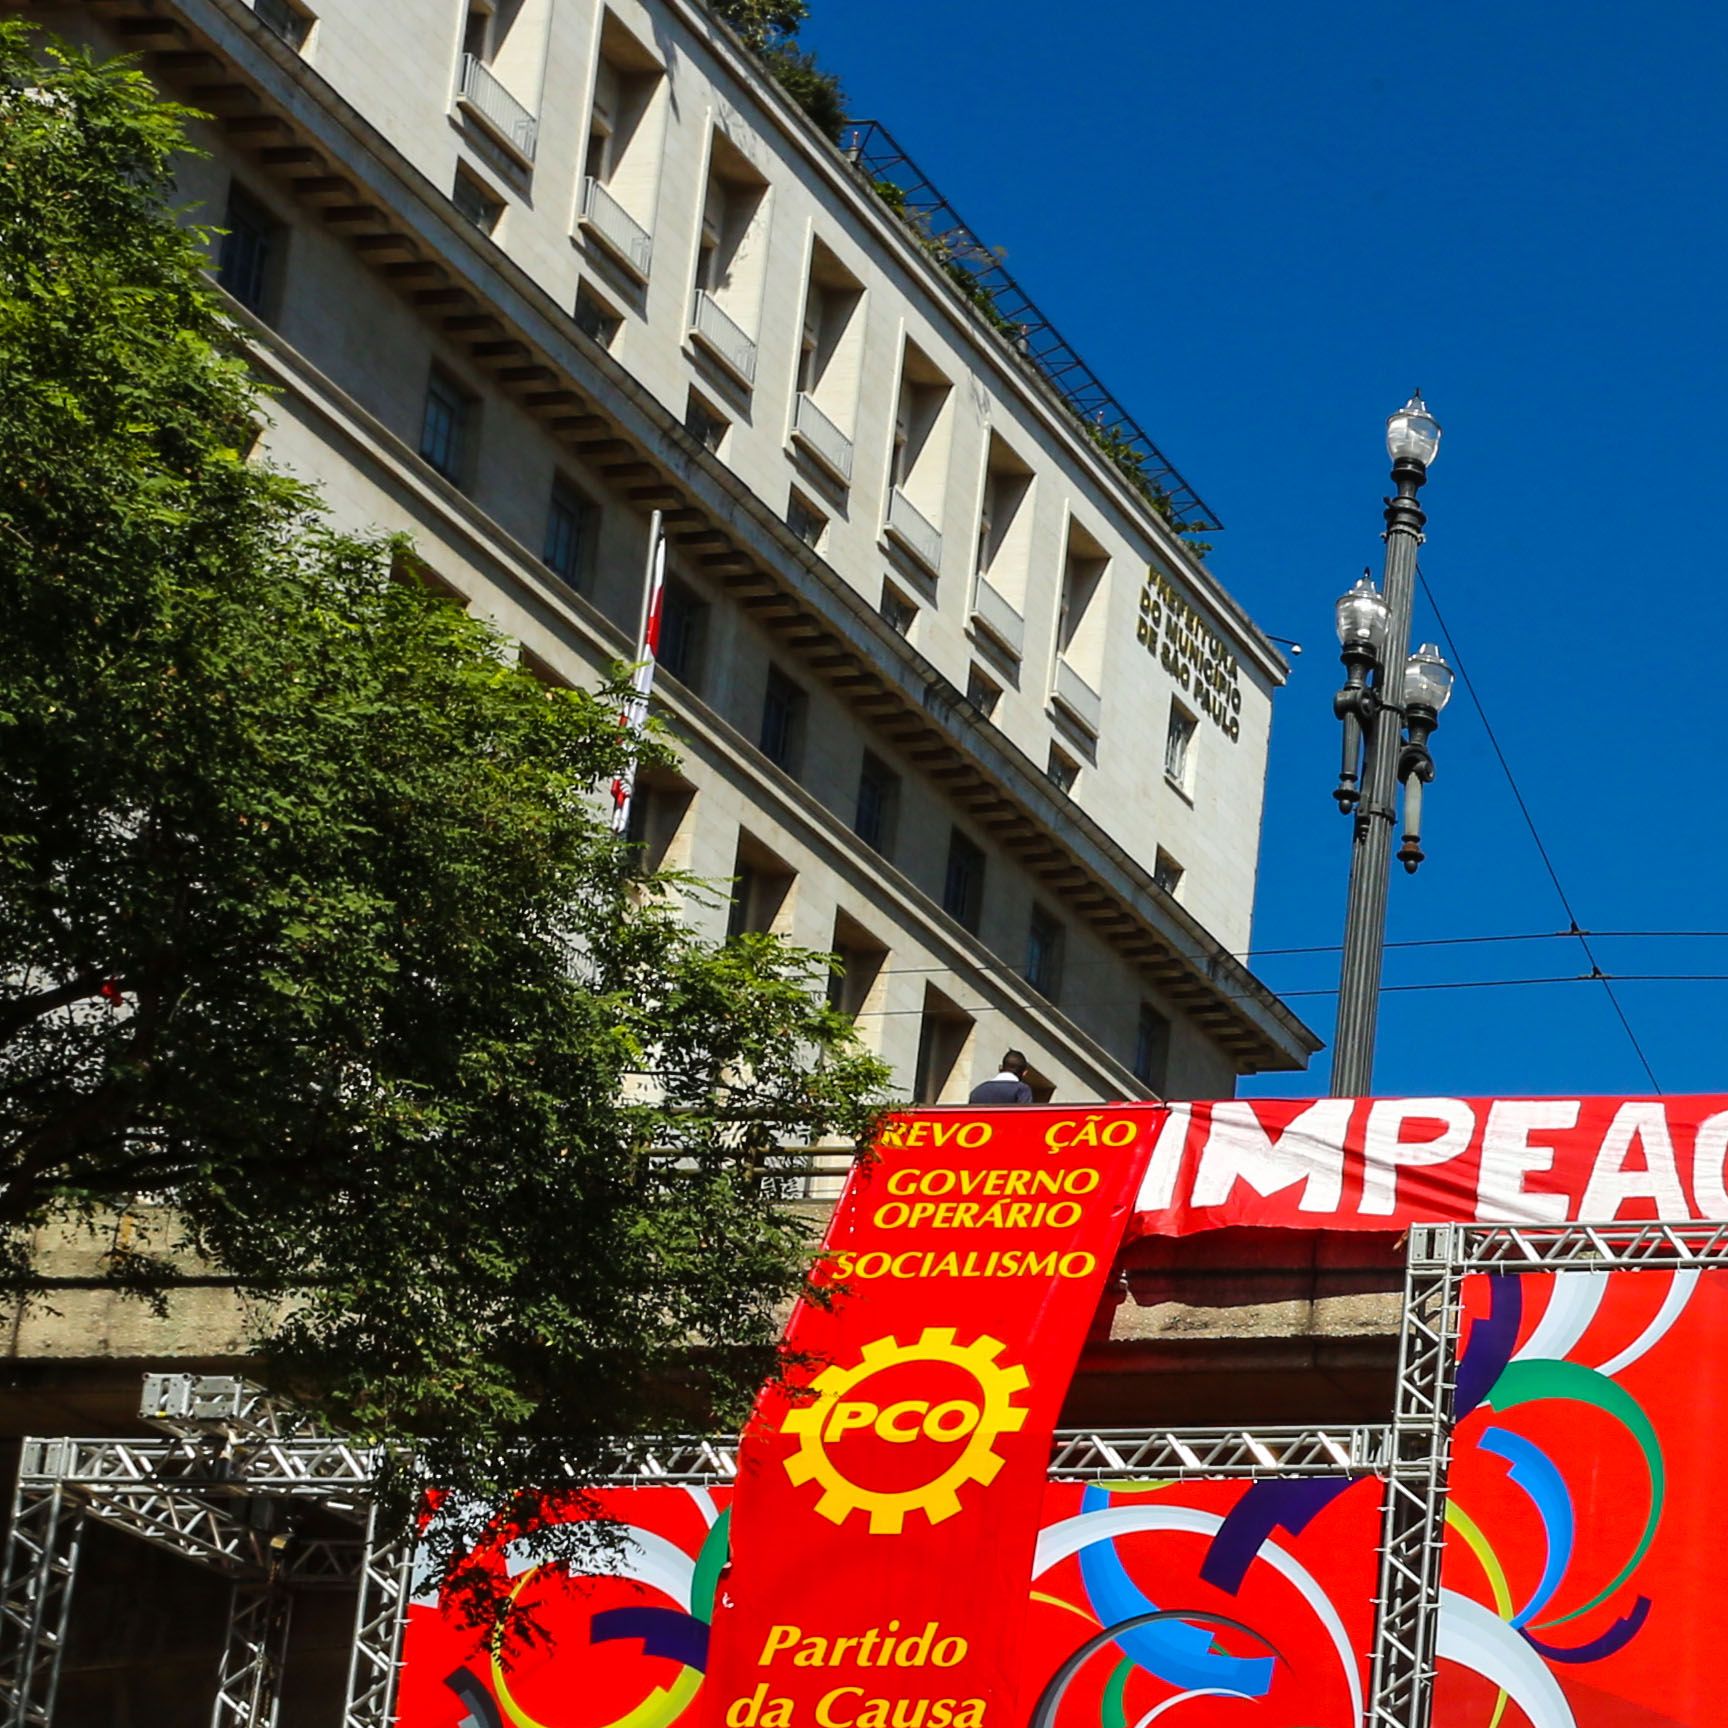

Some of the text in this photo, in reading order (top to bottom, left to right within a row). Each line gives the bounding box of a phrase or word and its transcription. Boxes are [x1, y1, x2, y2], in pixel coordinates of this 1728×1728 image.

[1139, 586, 1162, 629] DO
[1137, 614, 1159, 659] DE
[1194, 676, 1240, 744] PAULO
[887, 1168, 1100, 1196] GOVERNO
[872, 1196, 1083, 1229] OPERÁRIO
[832, 1250, 1096, 1280] SOCIALISMO
[821, 1401, 982, 1443] PCO
[758, 1622, 968, 1668] Partido
[725, 1682, 985, 1728] da Causa
